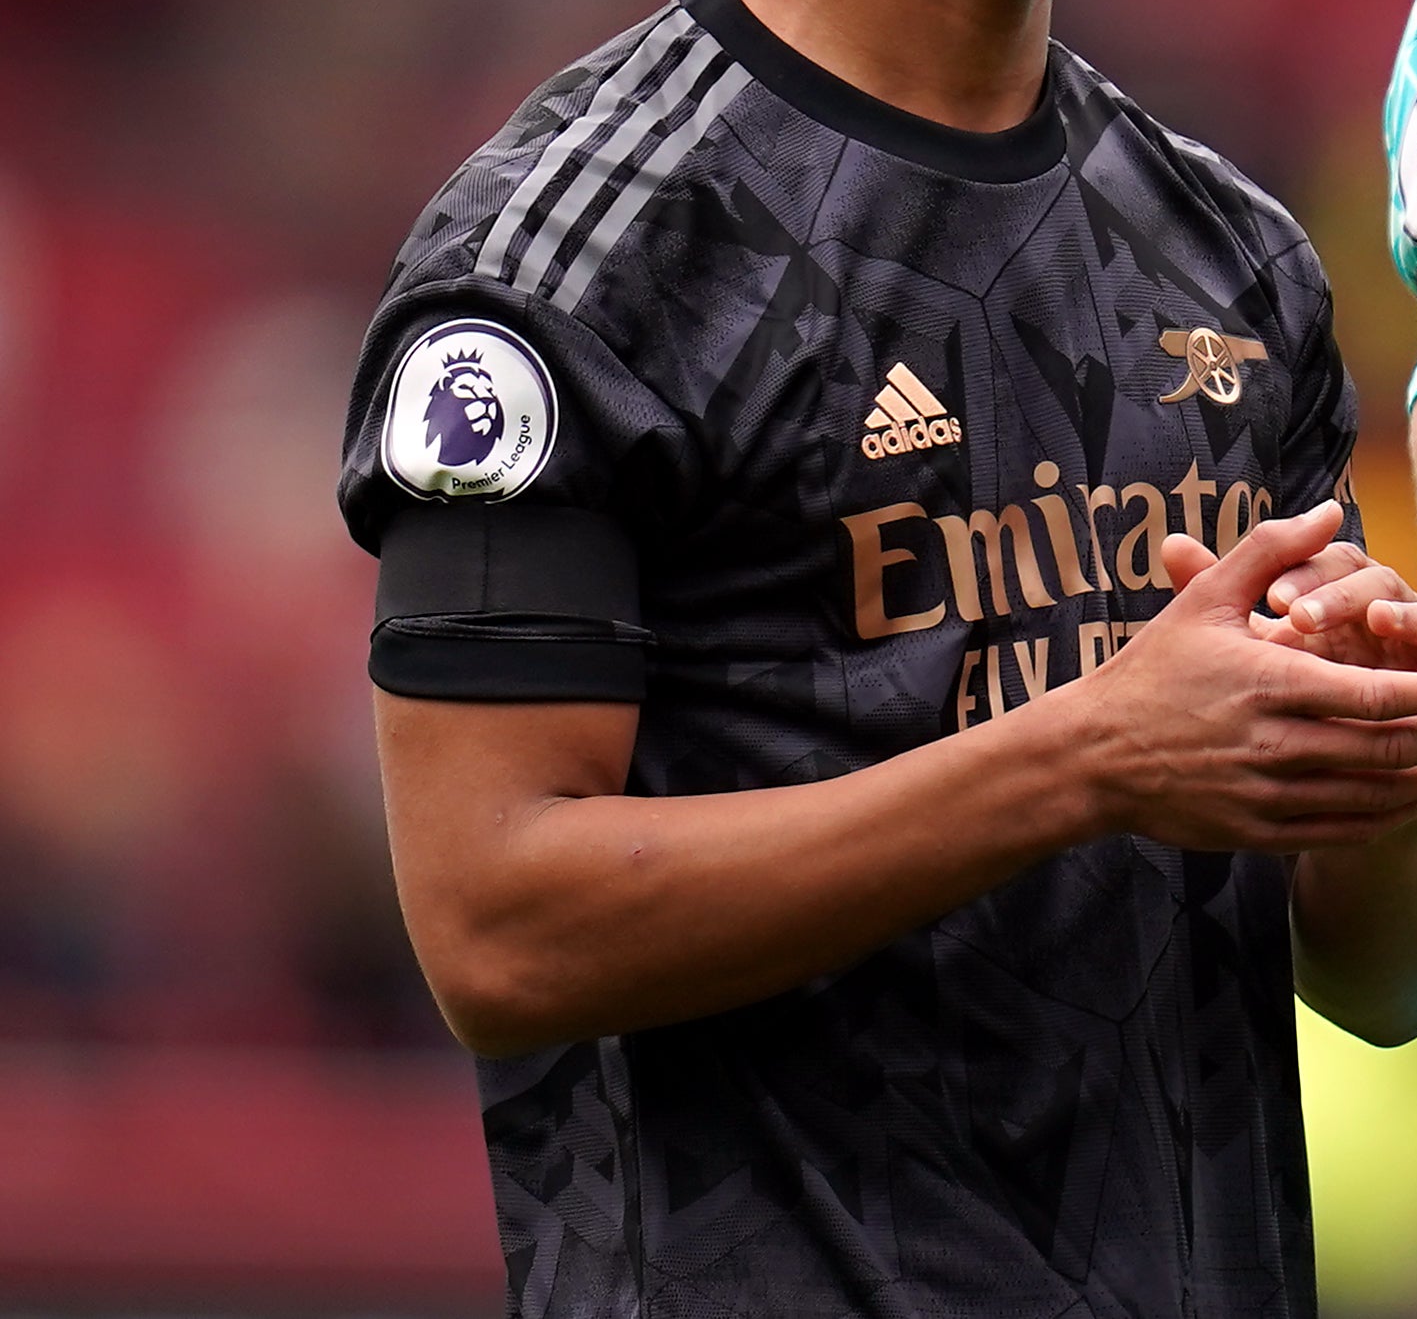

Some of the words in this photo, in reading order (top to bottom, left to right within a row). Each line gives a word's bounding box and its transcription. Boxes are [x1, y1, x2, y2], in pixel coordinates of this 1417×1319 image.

[452, 467, 505, 490] Premier
[501, 414, 533, 470] League
[861, 415, 962, 460] adidas
